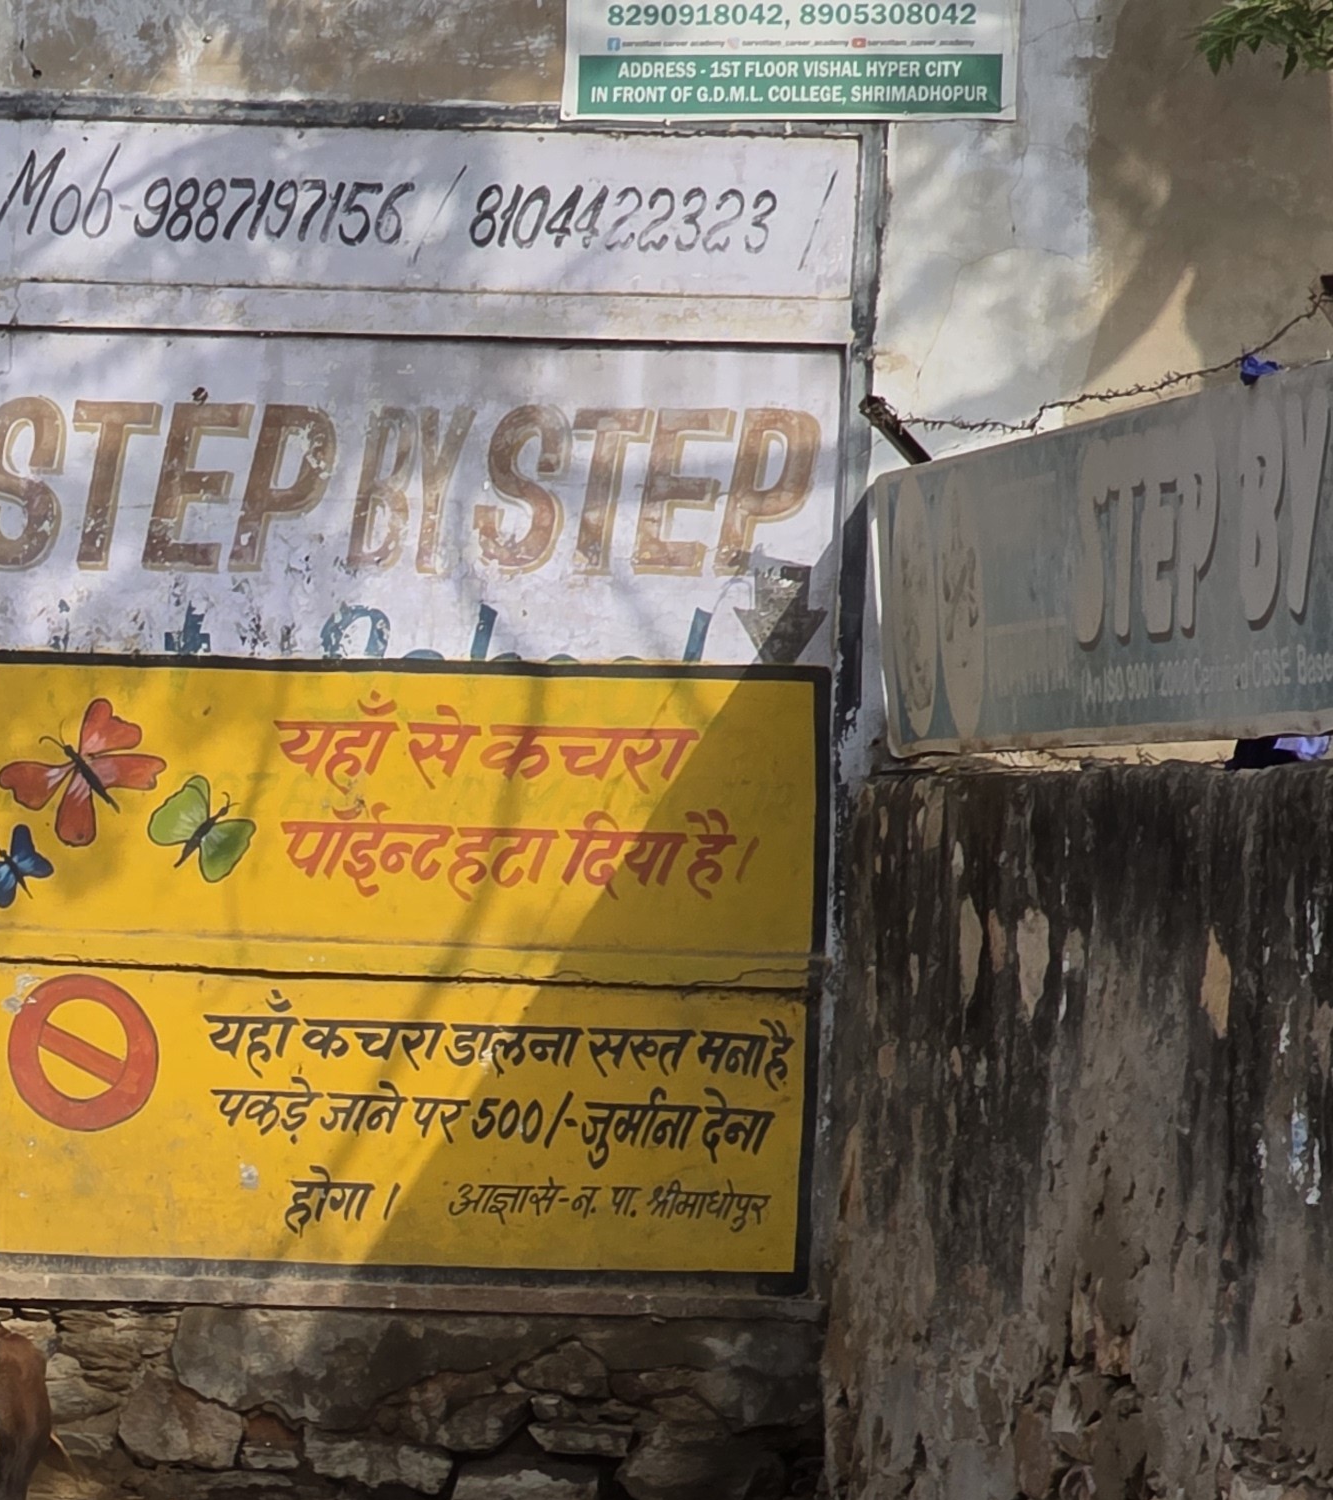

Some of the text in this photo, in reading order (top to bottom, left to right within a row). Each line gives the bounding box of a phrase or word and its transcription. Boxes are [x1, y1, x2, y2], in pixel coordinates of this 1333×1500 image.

[607, 2, 977, 30] 8290918042, 8905308042
[590, 84, 988, 105] IN FRONT OF G.D.M.L. COLLEGE, SHRIMADHOPUR
[618, 61, 697, 79] ADDRESS
[709, 61, 741, 79] 1ST
[745, 61, 799, 78] FLOOR
[803, 60, 862, 78] VISHAL
[866, 60, 921, 78] HYPER
[924, 60, 963, 78] CITY
[469, 183, 777, 254] 8104422323
[345, 404, 478, 574] BY
[472, 402, 823, 577] STEP
[1073, 388, 1331, 652] STEP BY
[1251, 646, 1293, 690] CBSE
[272, 689, 701, 796] यहाँ से कचरा
[447, 826, 561, 903] हटा
[561, 809, 689, 901] दिया
[202, 988, 300, 1079] यहाँ
[301, 1017, 447, 1072] कचरा
[444, 1023, 584, 1078] डालना
[209, 1075, 325, 1145] पकड़े
[319, 1080, 409, 1137] जाने
[411, 1095, 472, 1145] पर
[701, 1086, 776, 1164] देना
[646, 1178, 773, 1233] श्रीमाधोपुर
